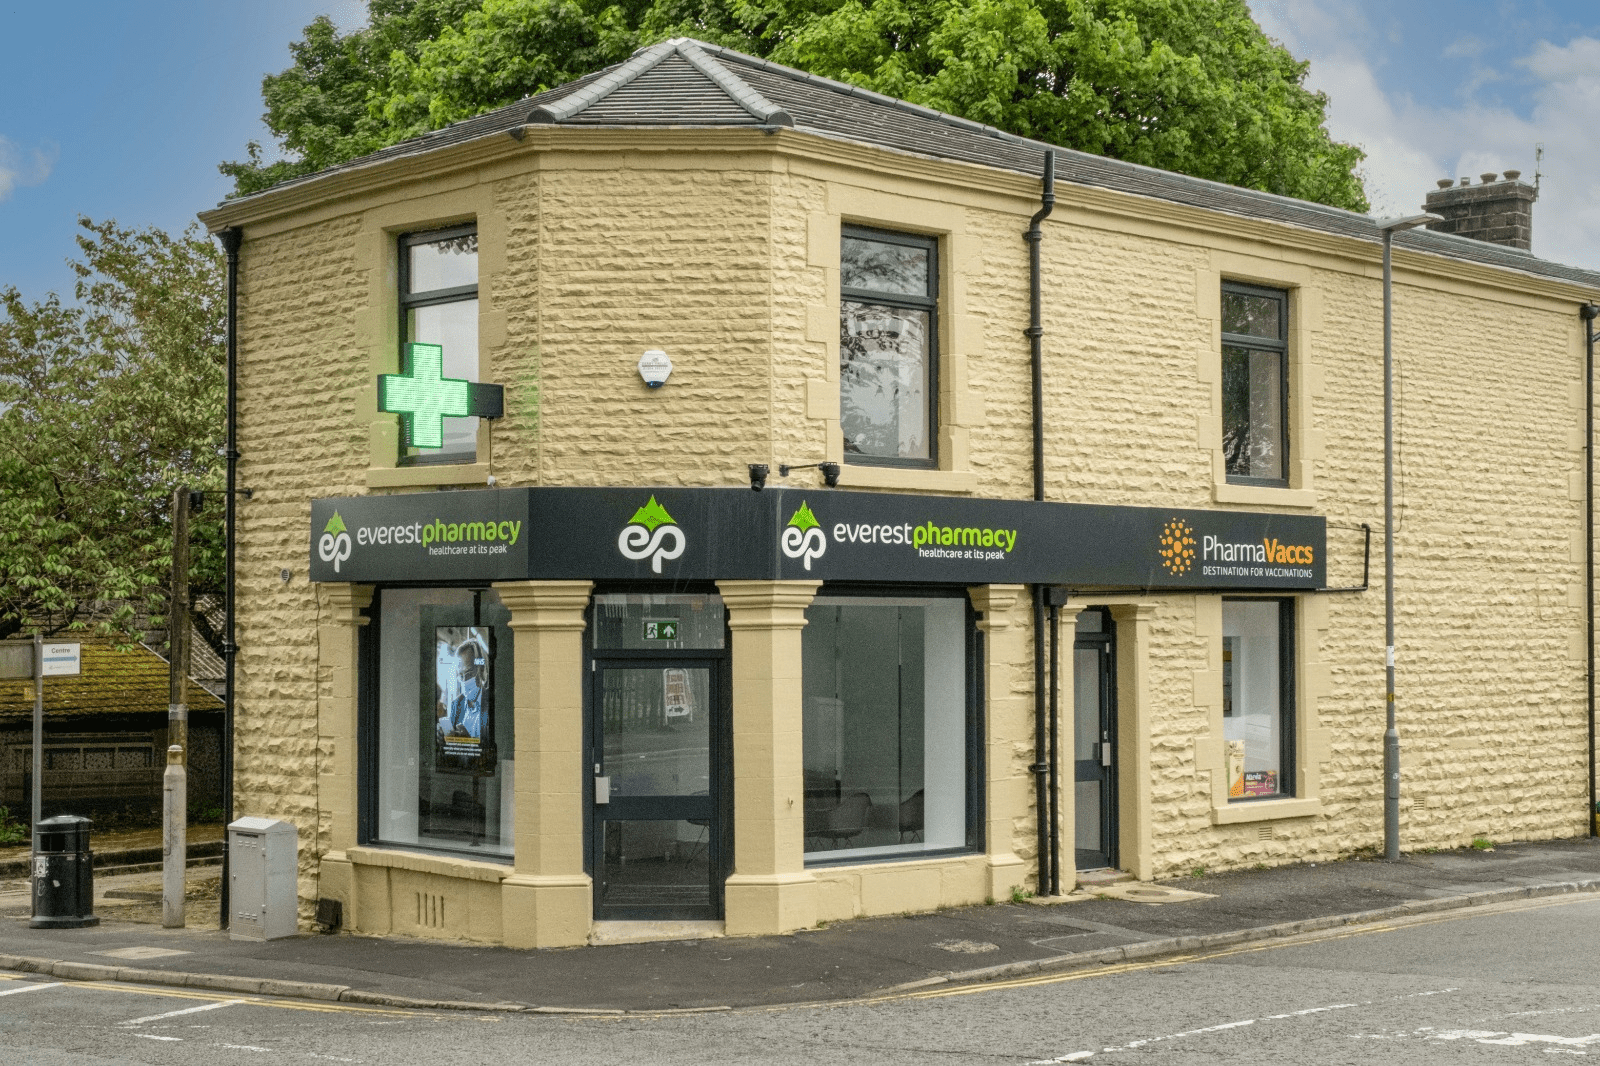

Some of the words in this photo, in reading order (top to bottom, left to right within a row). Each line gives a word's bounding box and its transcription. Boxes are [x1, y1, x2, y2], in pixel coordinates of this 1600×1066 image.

[429, 545, 467, 556] healthcare
[469, 545, 477, 555] at
[478, 544, 487, 555] its
[489, 544, 508, 556] peak
[919, 547, 963, 559] healthcare
[964, 549, 972, 559] at
[973, 549, 984, 559] its
[985, 550, 1005, 561] peak
[1203, 535, 1313, 564] PharmaVaccs
[1202, 565, 1249, 576] DESTINATION
[1250, 567, 1263, 577] FOR
[1265, 568, 1313, 578] VACCINATIONS
